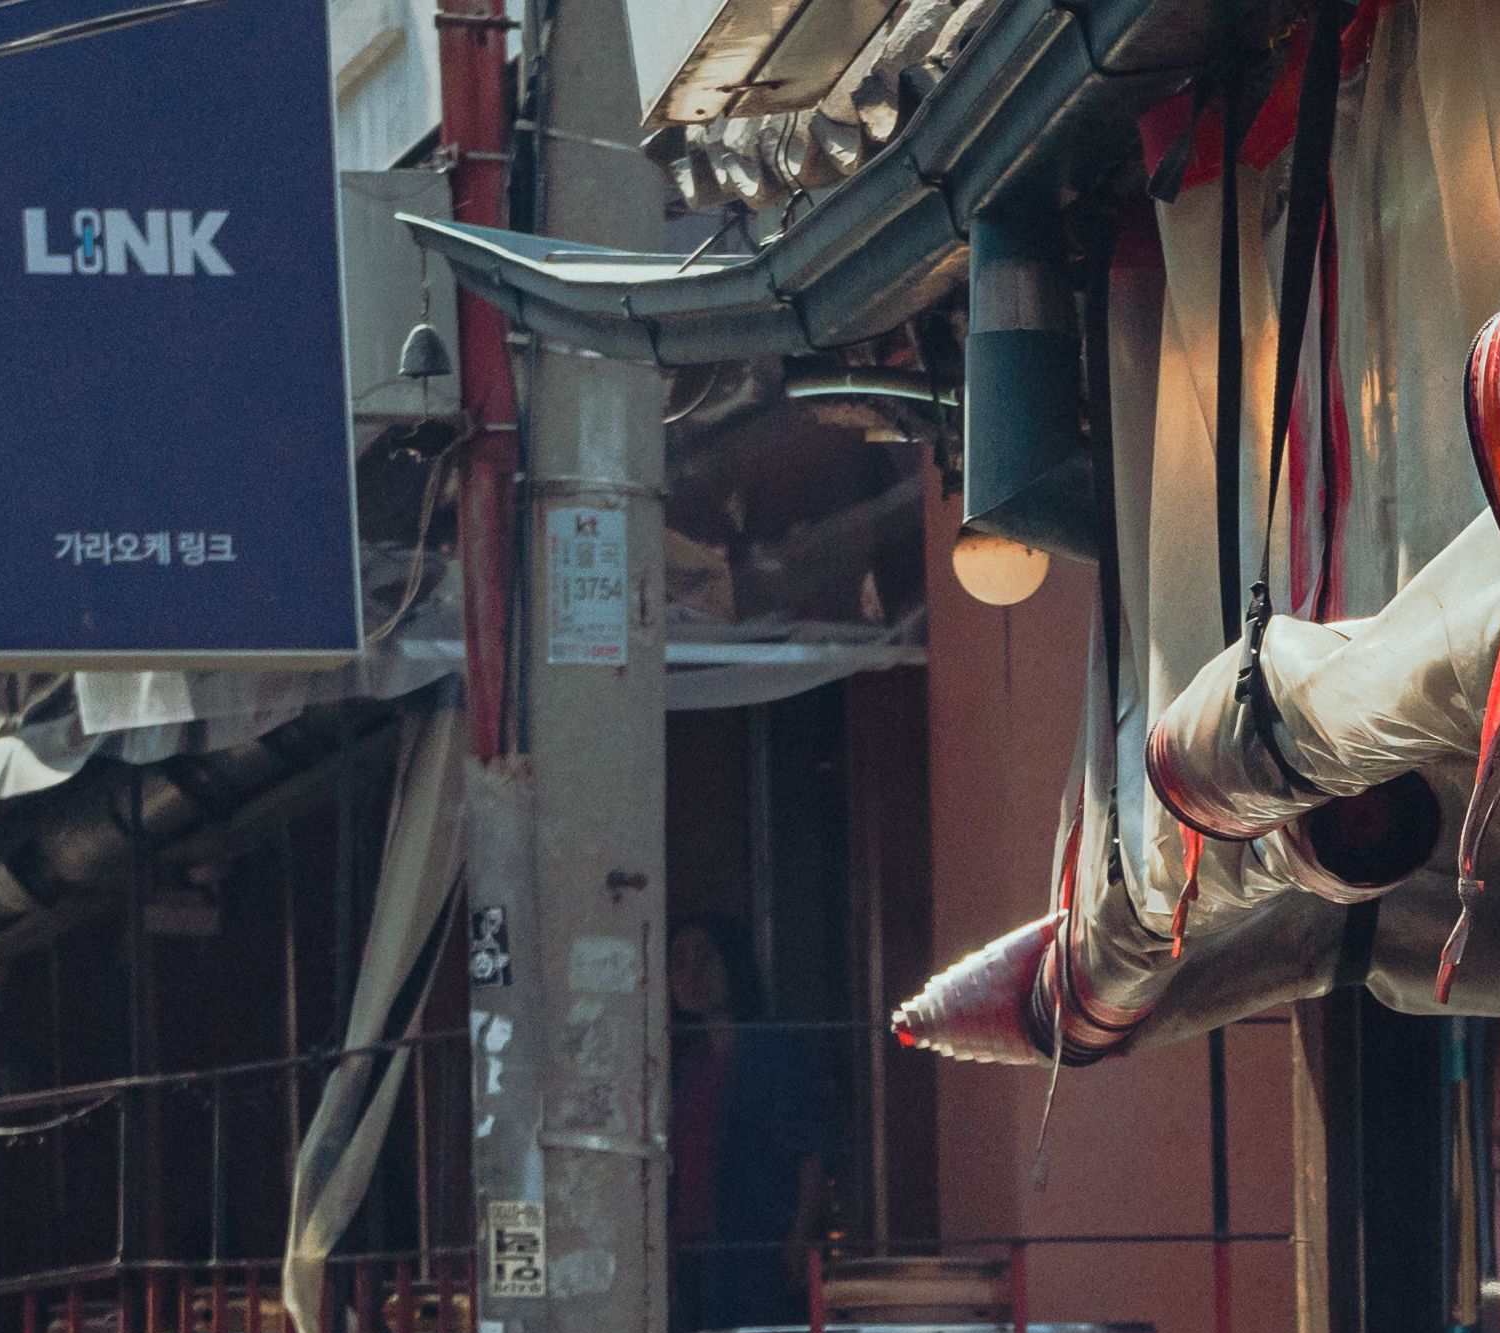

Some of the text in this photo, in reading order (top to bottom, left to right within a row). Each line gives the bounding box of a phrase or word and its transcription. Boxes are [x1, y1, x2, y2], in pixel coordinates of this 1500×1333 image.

[23, 208, 235, 276] LINK
[575, 514, 599, 536] kt
[55, 532, 238, 567] 가라오케 링크
[574, 577, 621, 600] 3754
